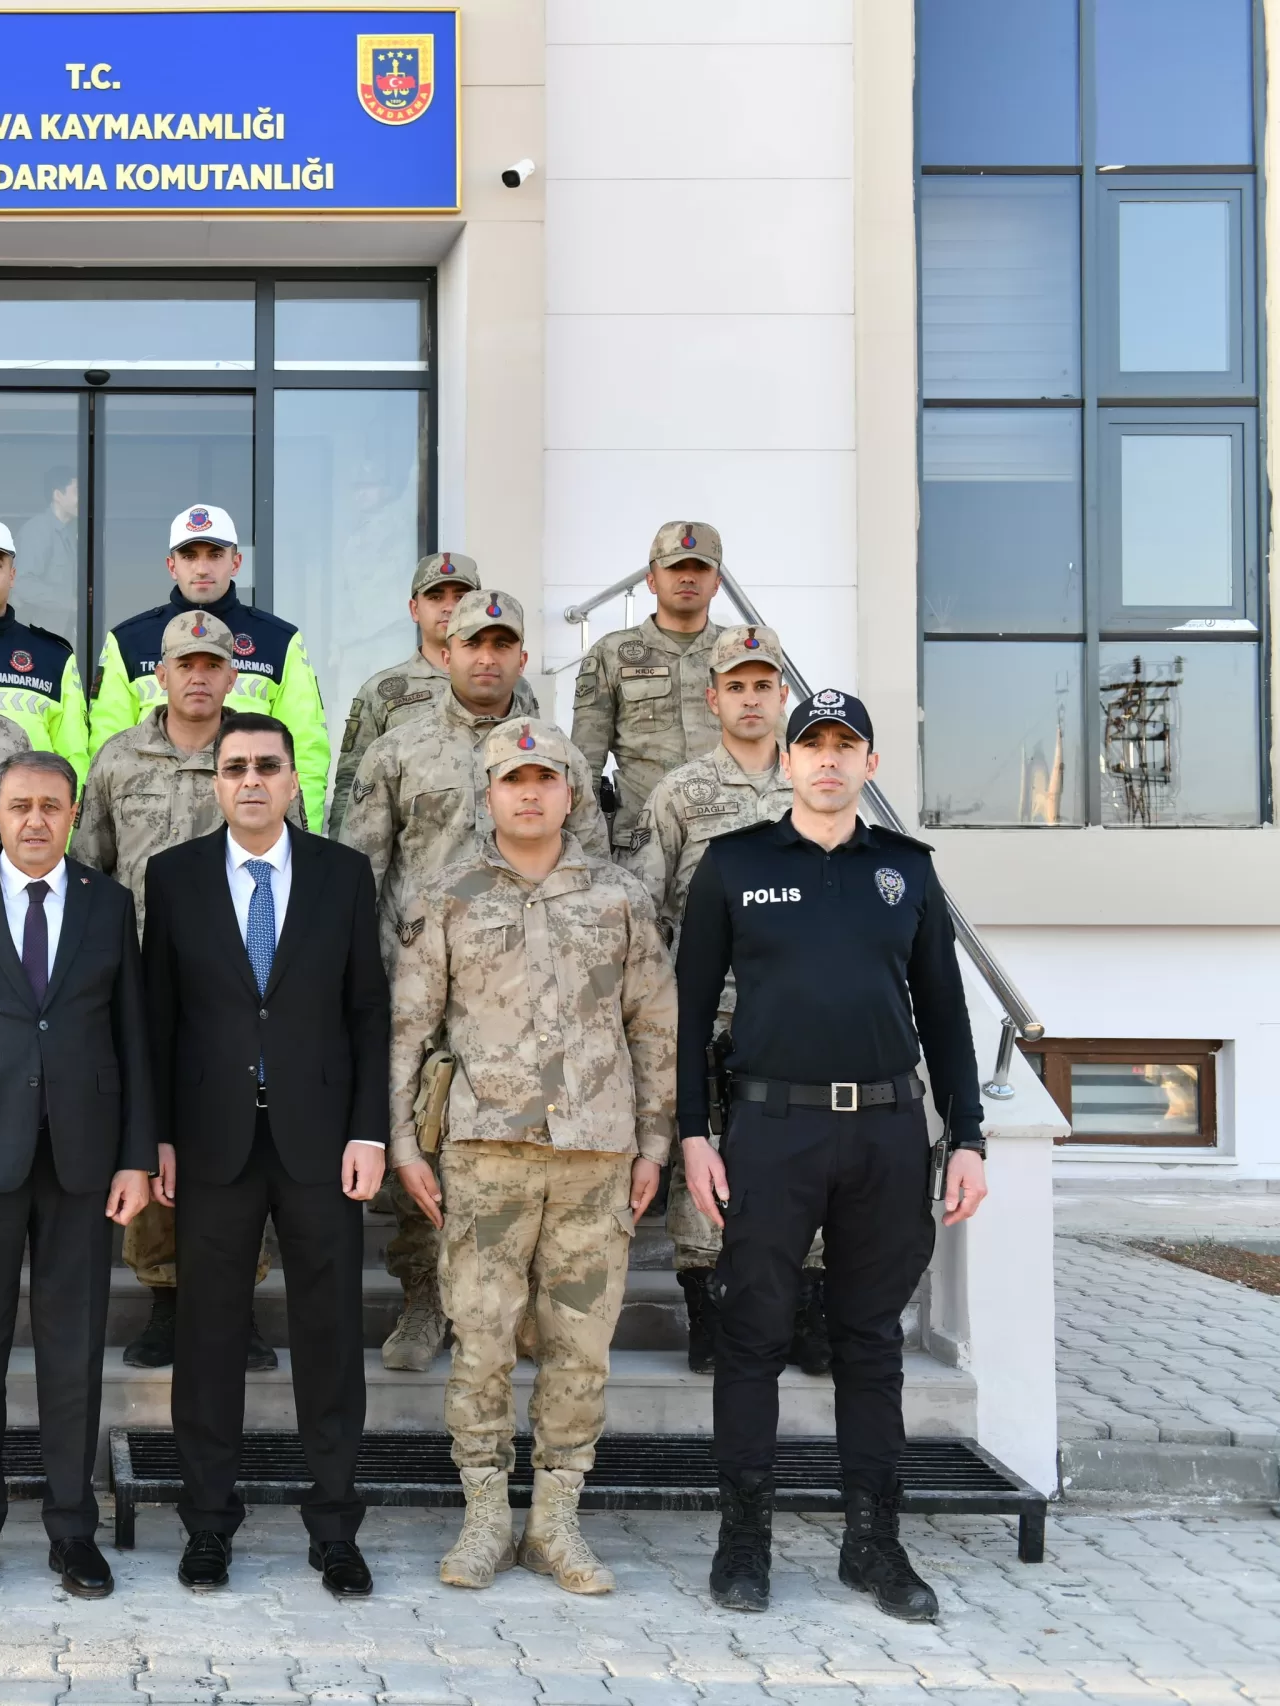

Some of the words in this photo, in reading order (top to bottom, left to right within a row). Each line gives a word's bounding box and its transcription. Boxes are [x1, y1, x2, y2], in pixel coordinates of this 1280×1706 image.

[65, 63, 122, 91] T.C.
[364, 92, 429, 119] JANDARMA
[40, 106, 286, 141] KAYMAKAMLIĞI
[115, 157, 335, 192] KOMUTANLIĞI
